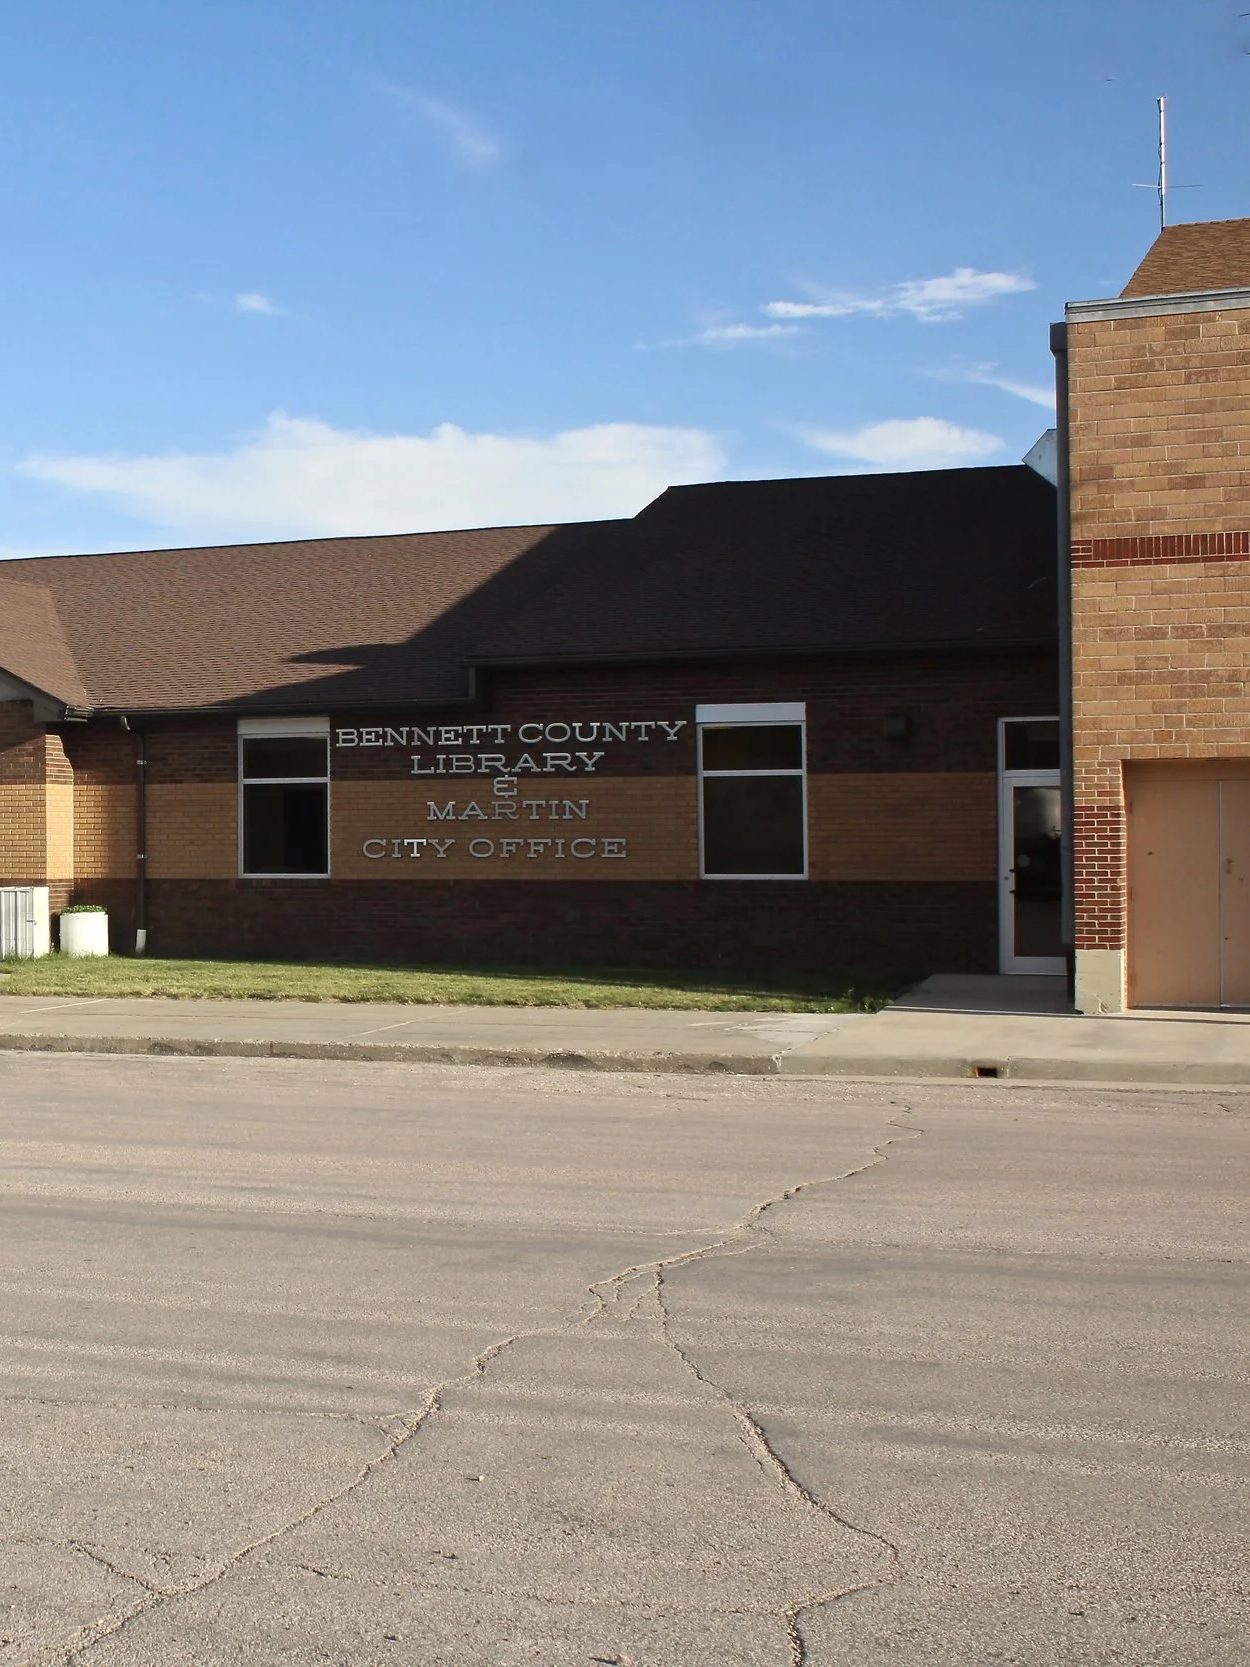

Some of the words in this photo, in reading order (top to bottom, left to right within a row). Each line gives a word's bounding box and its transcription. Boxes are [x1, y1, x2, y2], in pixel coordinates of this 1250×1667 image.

[336, 725, 511, 747] BENNETT
[518, 721, 687, 743] COUNTY
[411, 752, 605, 774] LIBRARY
[493, 775, 518, 798] &
[426, 800, 589, 820] MARTIN
[362, 839, 456, 858] CITY
[468, 838, 627, 858] OFFICE
